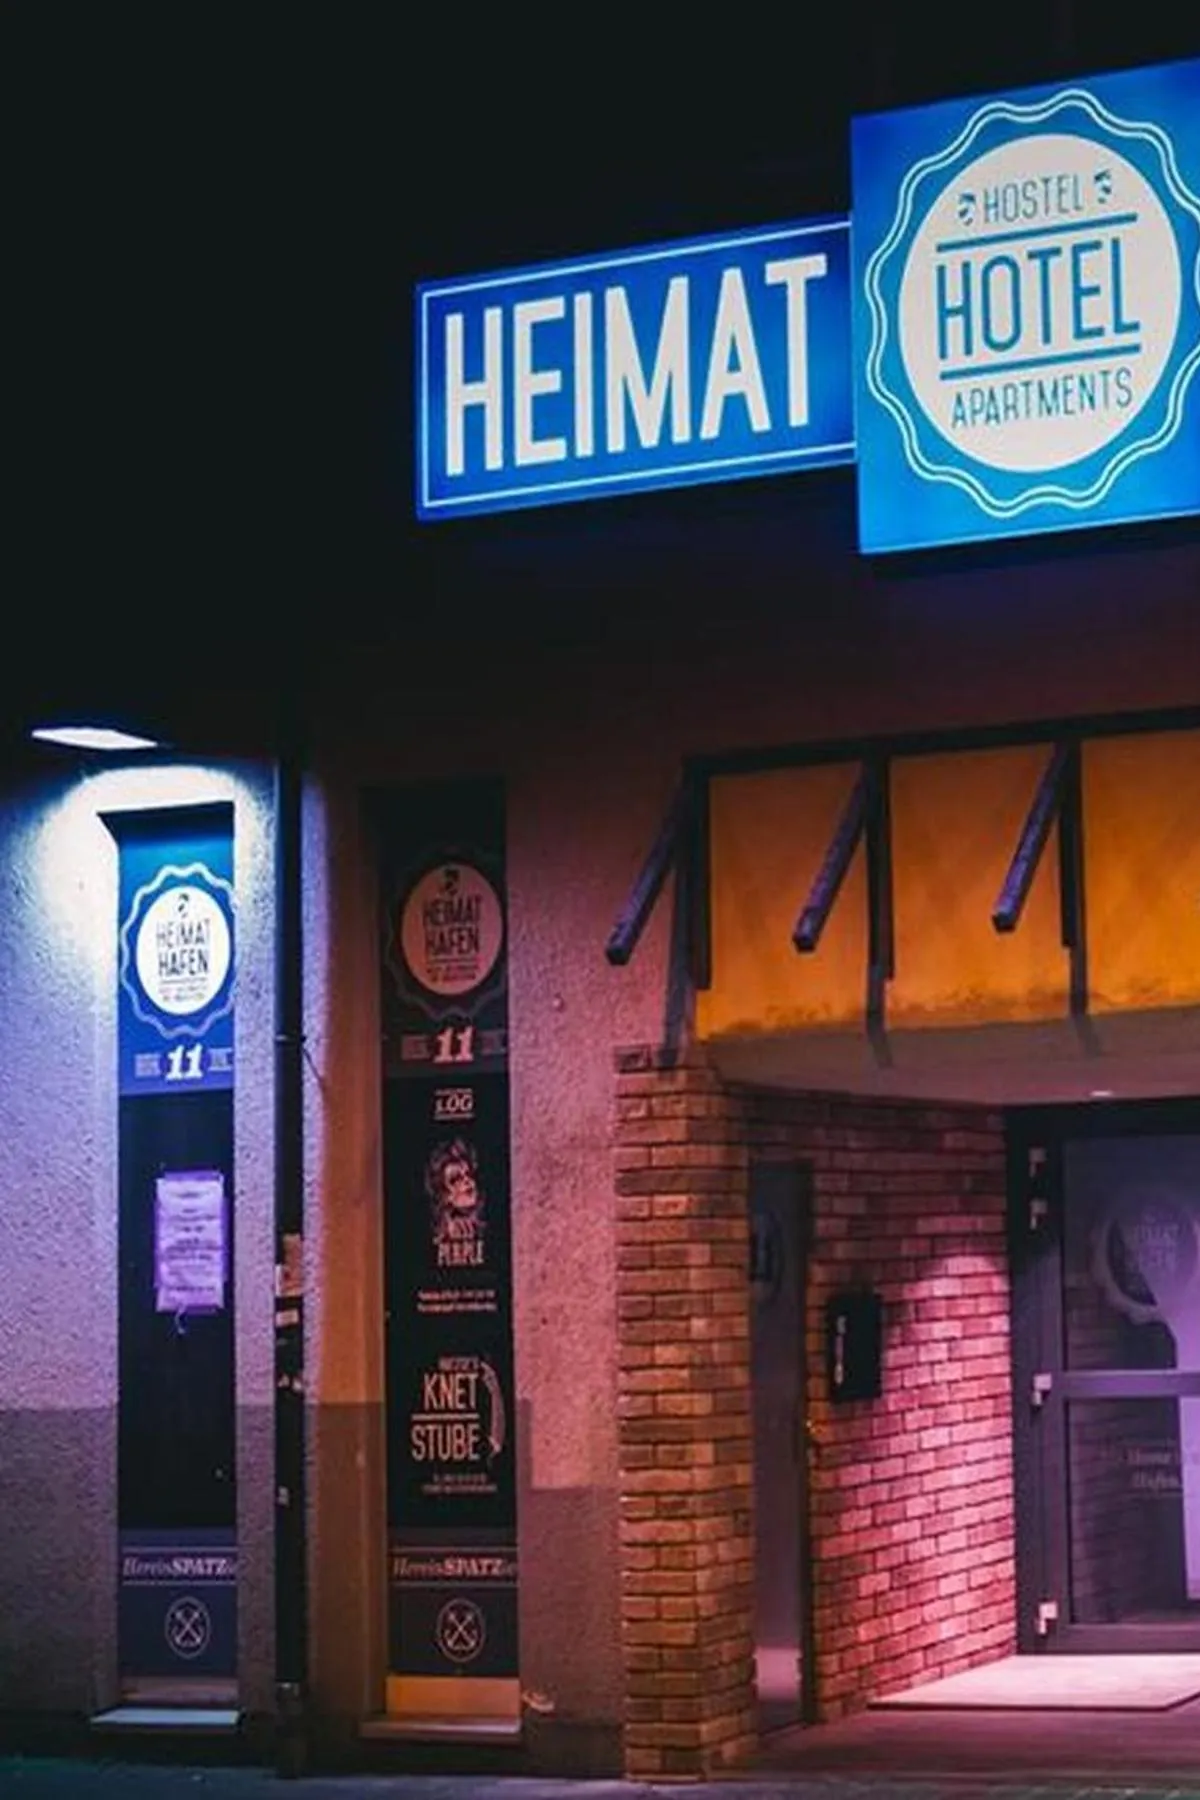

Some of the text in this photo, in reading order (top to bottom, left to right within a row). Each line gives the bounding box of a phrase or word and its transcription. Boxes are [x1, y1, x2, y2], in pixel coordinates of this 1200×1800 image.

[983, 173, 1083, 224] HOSTEL
[936, 237, 1140, 360] HOTEL
[445, 252, 827, 476] HEIMAT
[951, 367, 1133, 429] APARTMENTS
[422, 893, 483, 927] HEIMAT
[155, 917, 212, 949] HEIMAT
[424, 925, 480, 958] HAFEN
[157, 947, 210, 977] HAFEN
[165, 1042, 204, 1081] 11
[432, 1025, 476, 1064] 11
[423, 1372, 480, 1411] KNET
[411, 1423, 482, 1463] STUBE
